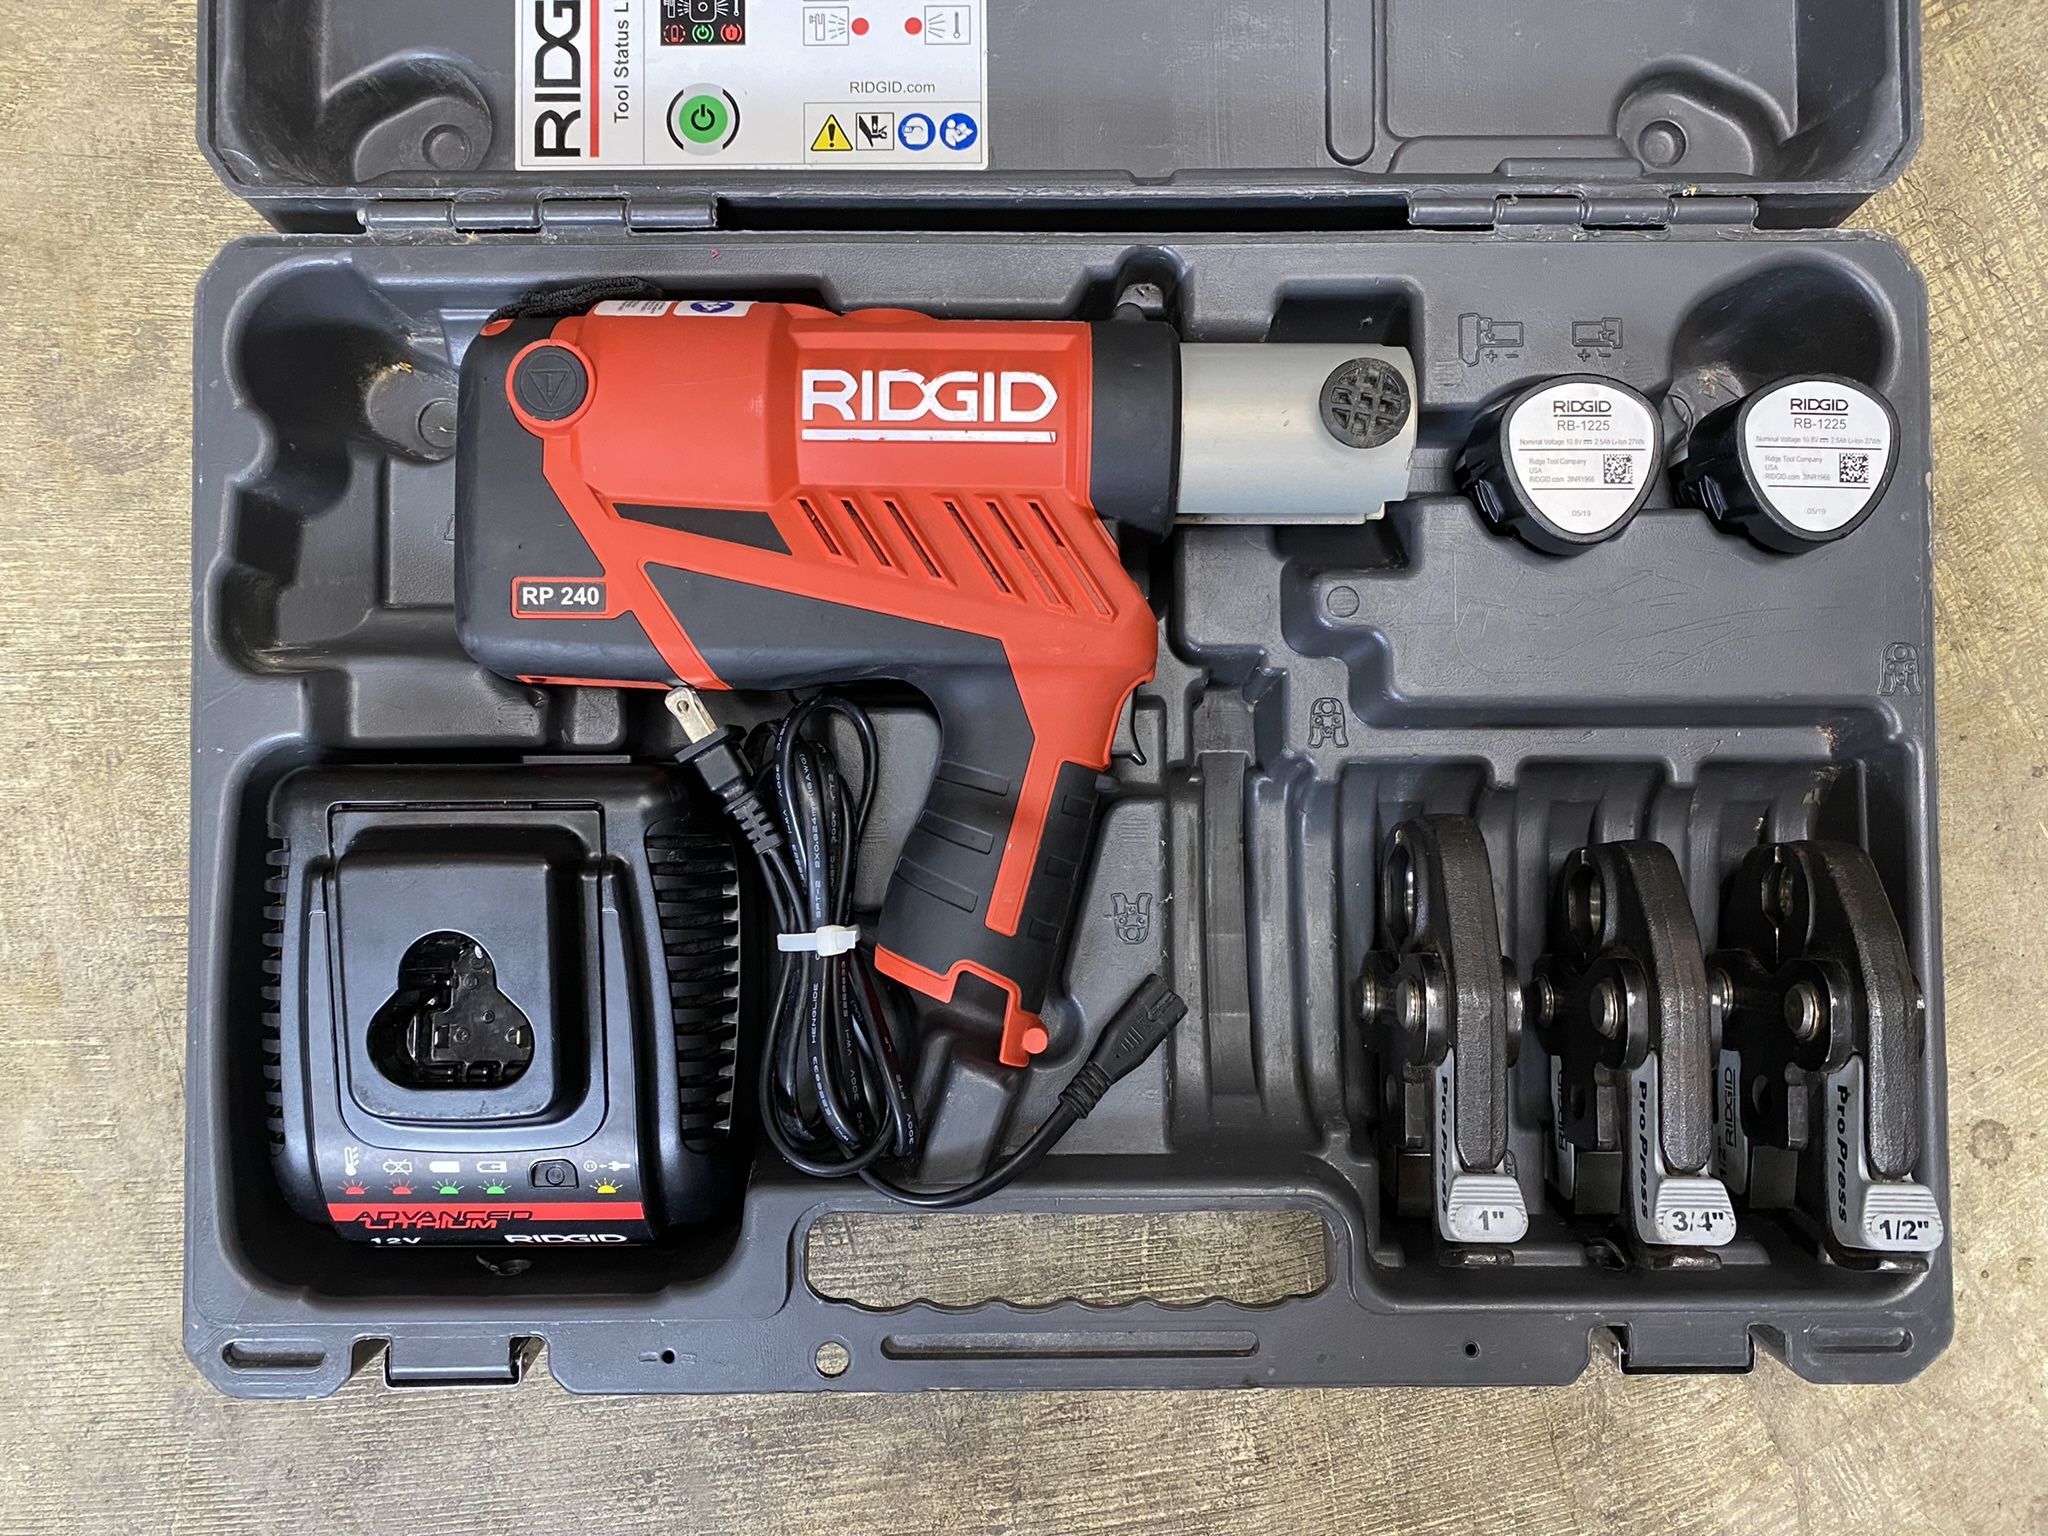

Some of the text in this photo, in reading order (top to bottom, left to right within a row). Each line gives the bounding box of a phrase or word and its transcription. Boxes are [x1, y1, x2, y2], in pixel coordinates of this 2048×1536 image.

[613, 20, 629, 78] Status
[534, 0, 581, 157] RIDG
[849, 80, 936, 93] RIDGID.com
[613, 85, 629, 123] Tool
[801, 369, 1059, 422] RIDGID
[1553, 400, 1612, 413] RIDGID
[1790, 398, 1849, 411] RIDGID
[1557, 420, 1610, 431] RB-1225
[1793, 418, 1847, 430] RB-1225
[1520, 438, 1542, 446] Nominal
[1545, 438, 1565, 446] Voltage
[1781, 436, 1801, 444] Voltage
[1529, 458, 1545, 466] Ridge
[1560, 458, 1587, 466] Company
[1765, 455, 1823, 464] Ridge Tool Company
[1765, 473, 1800, 481] RIDGID.com
[522, 586, 600, 606] RP 240
[1724, 1066, 1734, 1147] RIDGID
[354, 1210, 533, 1221] ADVANCED
[1478, 1210, 1504, 1231] 1"
[1672, 1211, 1724, 1232] 3/4"
[364, 1219, 498, 1229] LITHIUM
[1880, 1220, 1929, 1240] 1/2"
[370, 1237, 421, 1245] 12V
[504, 1234, 628, 1243] RIDGID
